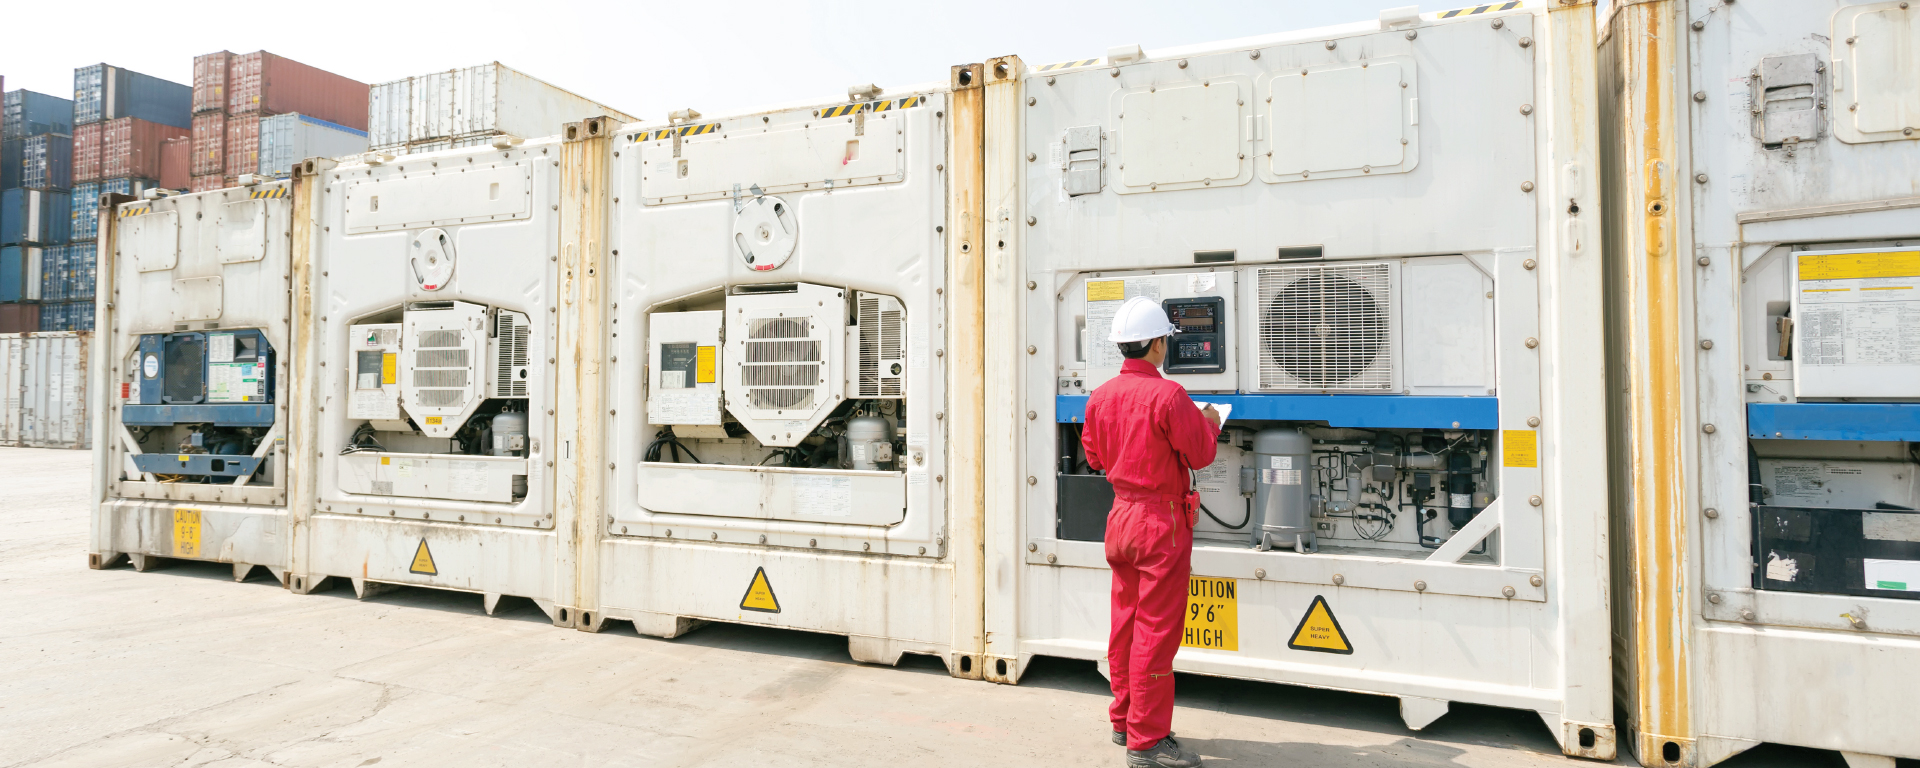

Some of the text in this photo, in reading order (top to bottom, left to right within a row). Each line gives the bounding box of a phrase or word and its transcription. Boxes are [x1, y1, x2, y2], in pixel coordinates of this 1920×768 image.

[175, 509, 201, 525] CAUTION
[180, 541, 194, 555] HIGH
[1188, 579, 1235, 599] UTION
[1191, 602, 1225, 623] 9'6"
[1185, 627, 1223, 647] HIGH
